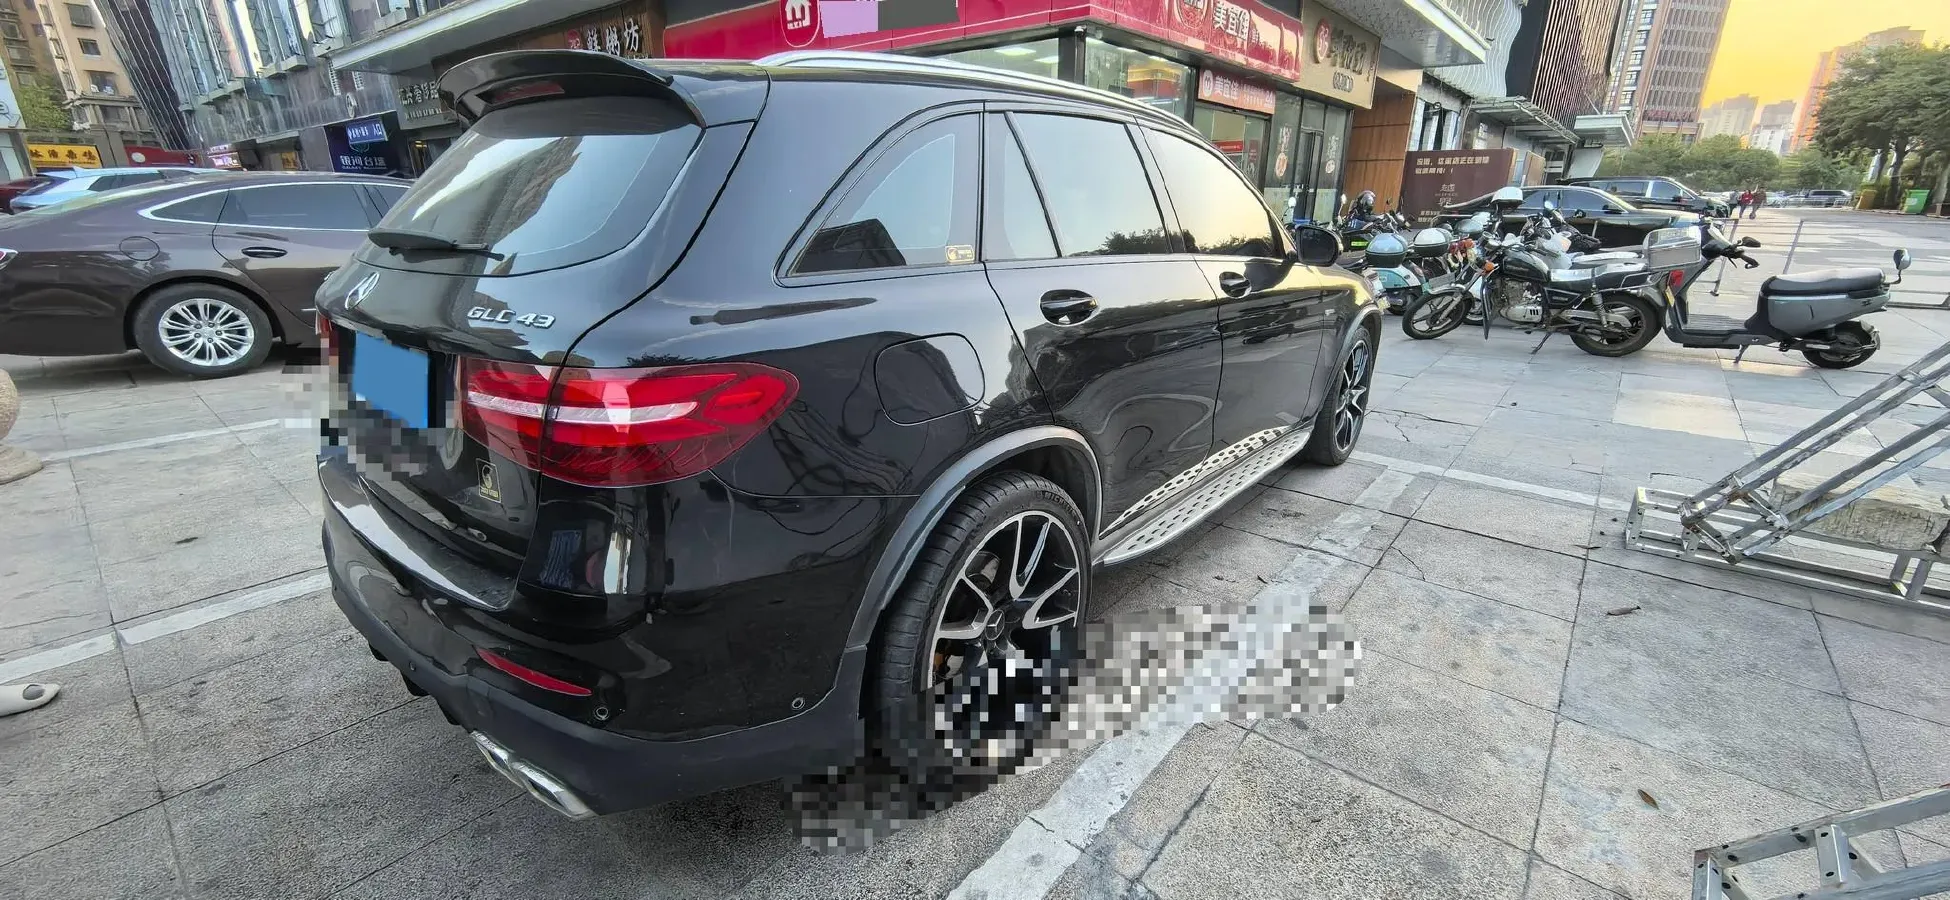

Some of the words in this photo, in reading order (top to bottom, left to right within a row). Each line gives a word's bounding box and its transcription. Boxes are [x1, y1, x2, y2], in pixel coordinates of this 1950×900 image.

[1213, 75, 1240, 101] 美宜佳
[467, 306, 516, 324] GLC
[516, 312, 556, 330] 43
